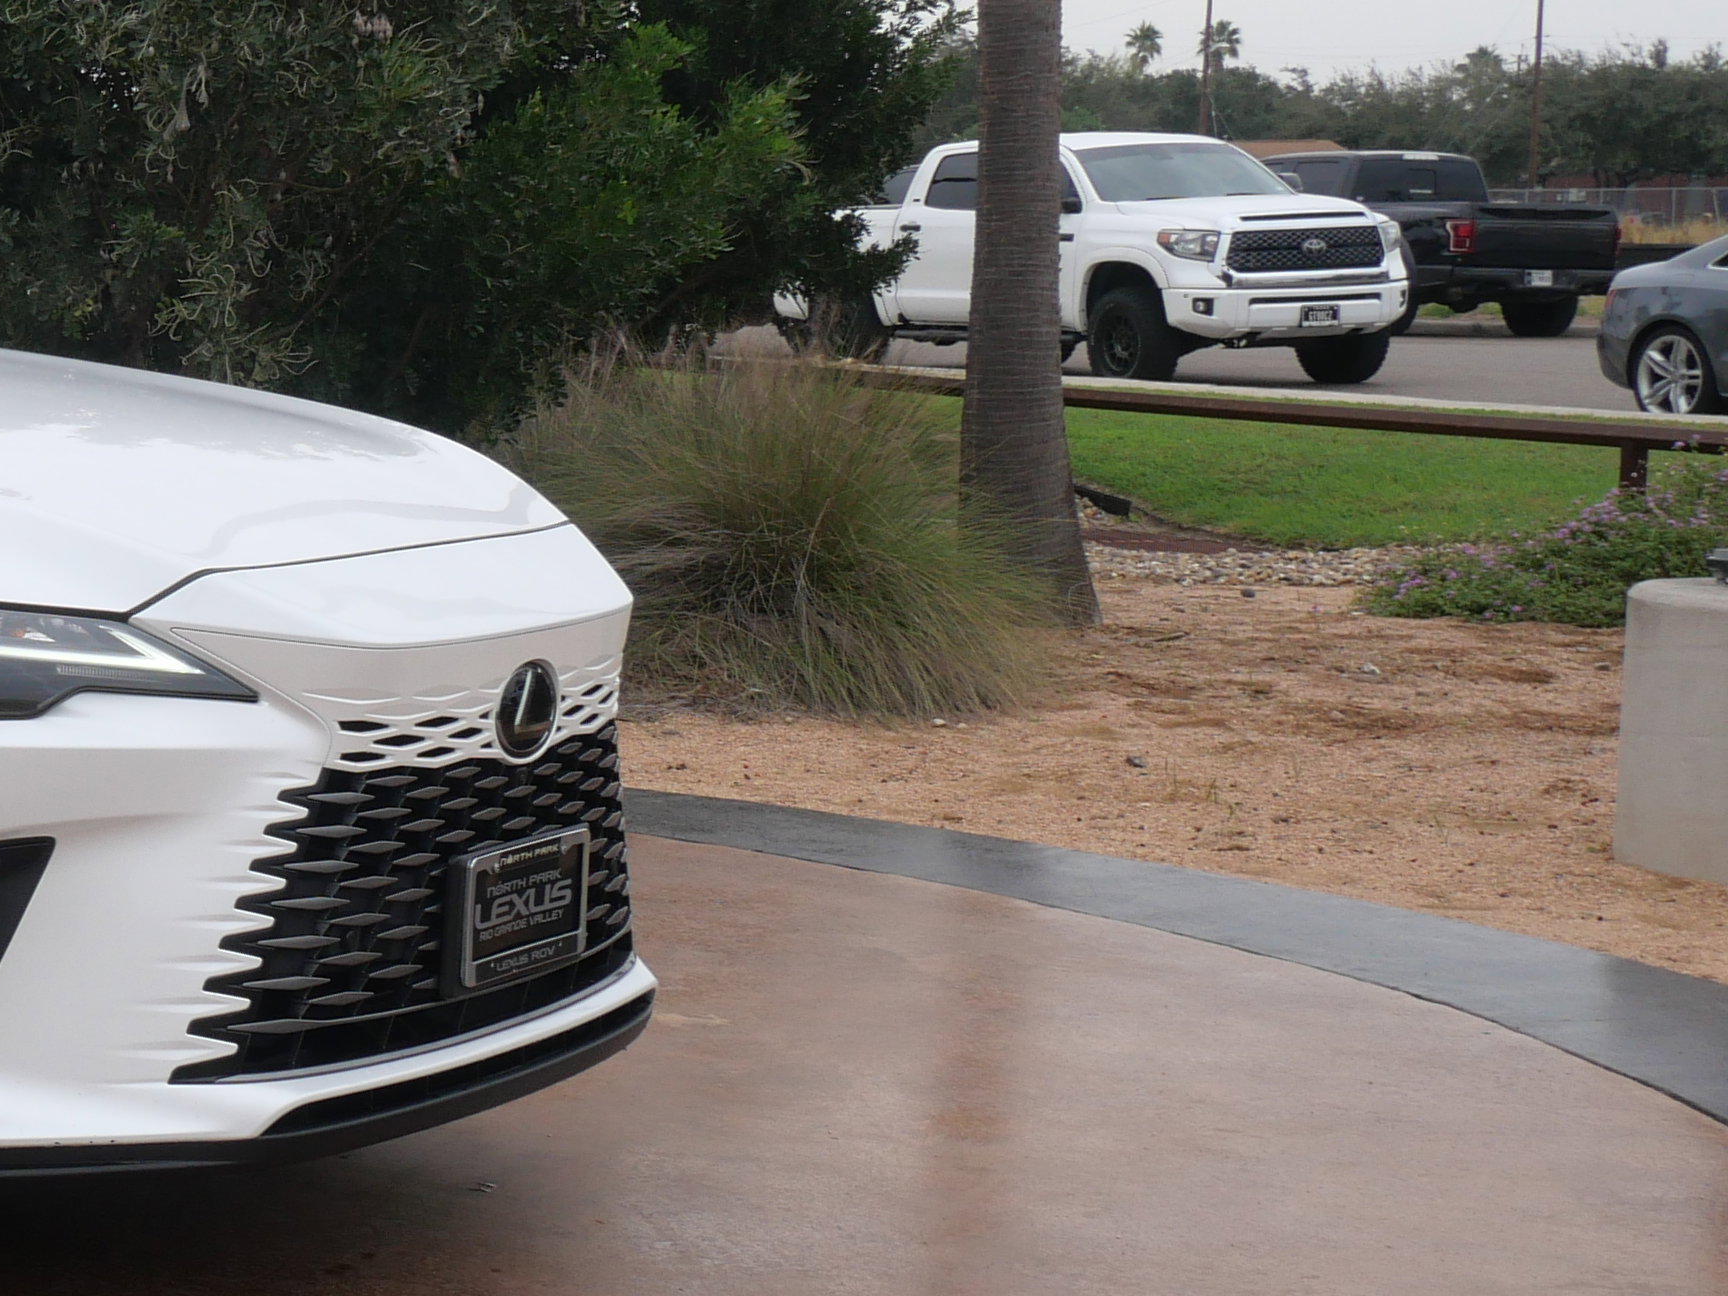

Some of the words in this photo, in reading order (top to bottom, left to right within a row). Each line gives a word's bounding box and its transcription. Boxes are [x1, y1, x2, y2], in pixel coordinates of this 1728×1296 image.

[534, 843, 560, 858] PARK
[528, 868, 562, 887] PARK
[474, 878, 573, 930] LEXUS
[529, 908, 564, 925] VALLEY
[496, 954, 530, 971] LEXUS
